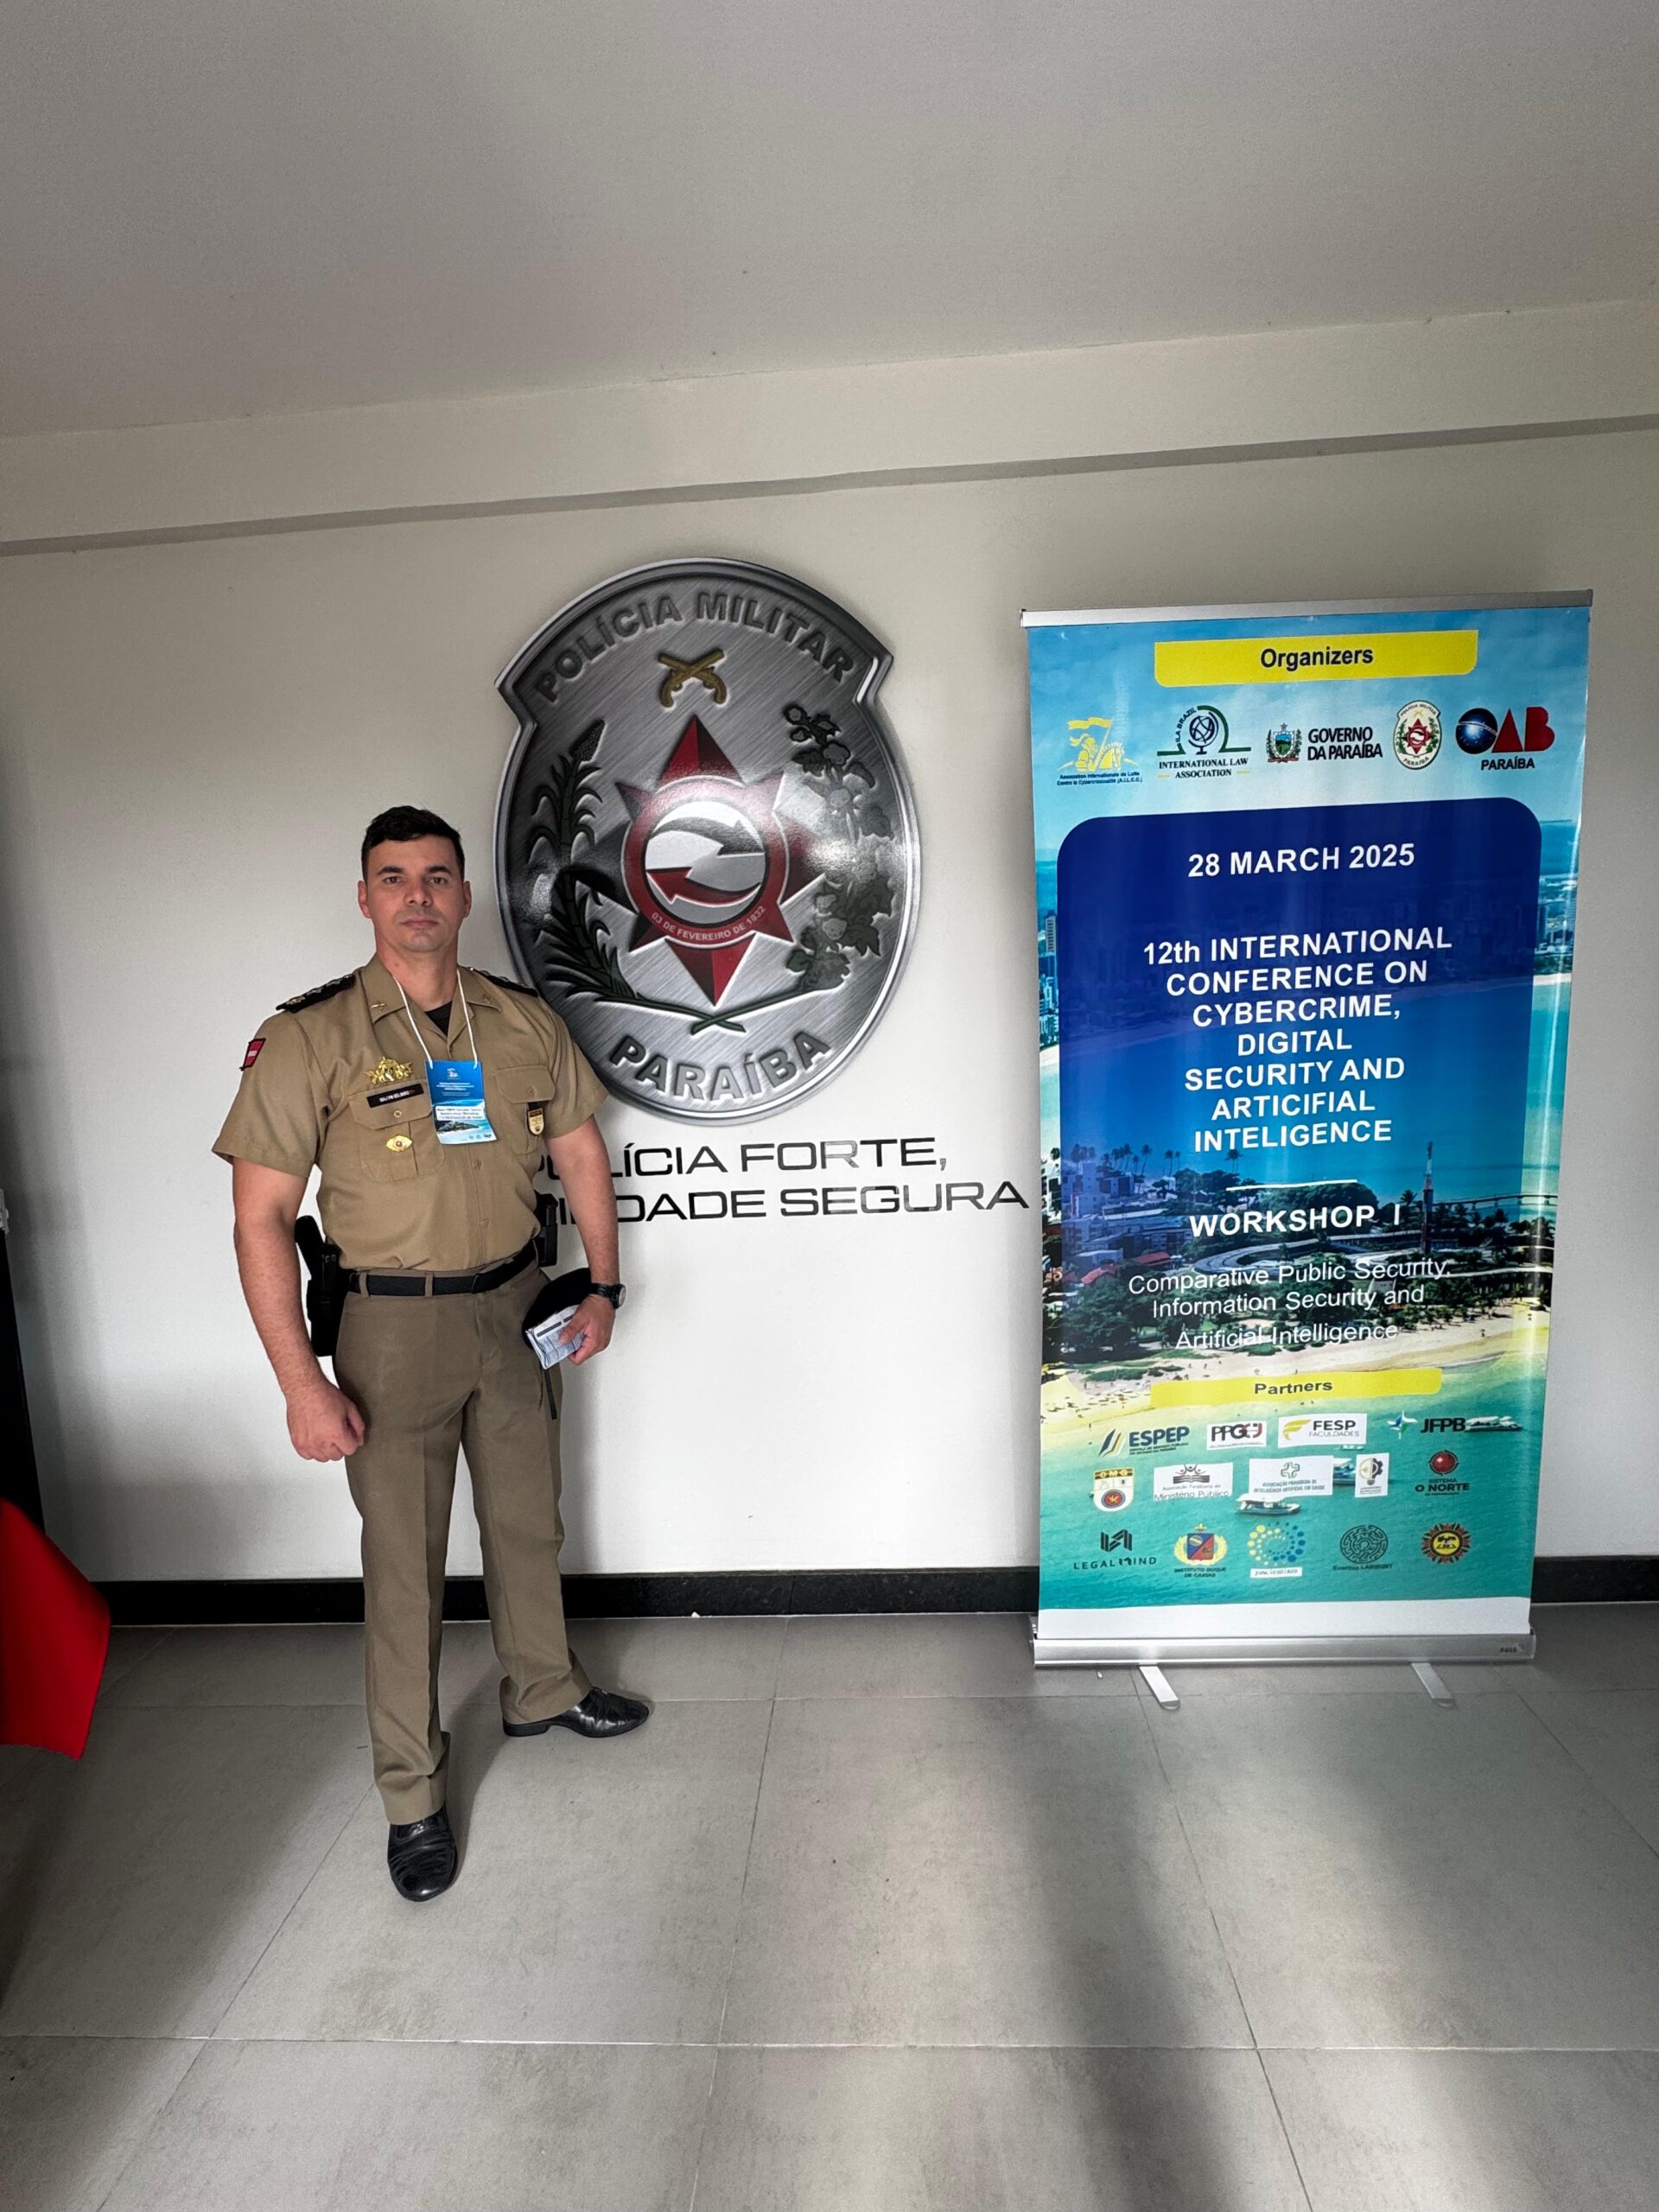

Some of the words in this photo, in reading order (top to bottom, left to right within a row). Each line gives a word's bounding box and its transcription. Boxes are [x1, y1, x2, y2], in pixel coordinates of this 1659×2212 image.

[537, 593, 683, 702] POLÍCIA
[696, 591, 855, 683] MILITAR
[1261, 646, 1374, 672] Organizers
[1177, 708, 1197, 728] BRAZIL
[1456, 706, 1555, 754] OAB
[1307, 727, 1373, 744] GOVERNO
[1307, 745, 1326, 760] DA
[1329, 741, 1382, 760] PARAÍBA
[1159, 759, 1229, 769] INTERNATIONAL
[1230, 758, 1249, 766] LAW
[1175, 769, 1232, 779] ASSOCIATION
[1480, 756, 1535, 771] PARAÍBA
[1188, 854, 1219, 878] 28
[1230, 847, 1340, 875] MARCH
[1350, 843, 1415, 869] 2025
[652, 912, 663, 924] 03
[664, 922, 676, 932] DE
[677, 928, 732, 941] FEVEREIRO
[733, 924, 746, 934] DE
[747, 906, 766, 925] 1832
[1144, 941, 1200, 965] 12th
[1211, 926, 1452, 963] INTERNATIONAL
[1166, 963, 1374, 996] CONFERENCE
[1384, 961, 1427, 983] ON
[1193, 995, 1401, 1028] CYBERCRIME,
[1237, 1029, 1352, 1057] DIGITAL
[608, 1031, 832, 1103] PARAÍBA
[1185, 1060, 1333, 1091] SECURITY
[1340, 1058, 1405, 1081] AND
[1211, 1090, 1376, 1121] ARTICIFIAL
[1194, 1120, 1392, 1153] INTELIGENCE
[537, 1142, 728, 1180] ÍCIA
[741, 1137, 947, 1172] FORTE,
[780, 1180, 1030, 1216] SEGURA
[1189, 1205, 1376, 1236] WORKSHOP
[1394, 1204, 1401, 1225] I
[1128, 1265, 1268, 1294] Comparative
[1279, 1261, 1345, 1284] Public
[1153, 1294, 1276, 1319] Information
[1286, 1288, 1376, 1317] Security
[1384, 1285, 1424, 1305] and
[1176, 1325, 1261, 1350] Artificial
[1272, 1319, 1399, 1346] Intelligence
[1255, 1379, 1332, 1395] Partners
[1129, 1426, 1190, 1447] ESPEP
[1313, 1420, 1356, 1431] FESP
[1421, 1417, 1465, 1433] JFPB
[1428, 1483, 1470, 1491] NORTE
